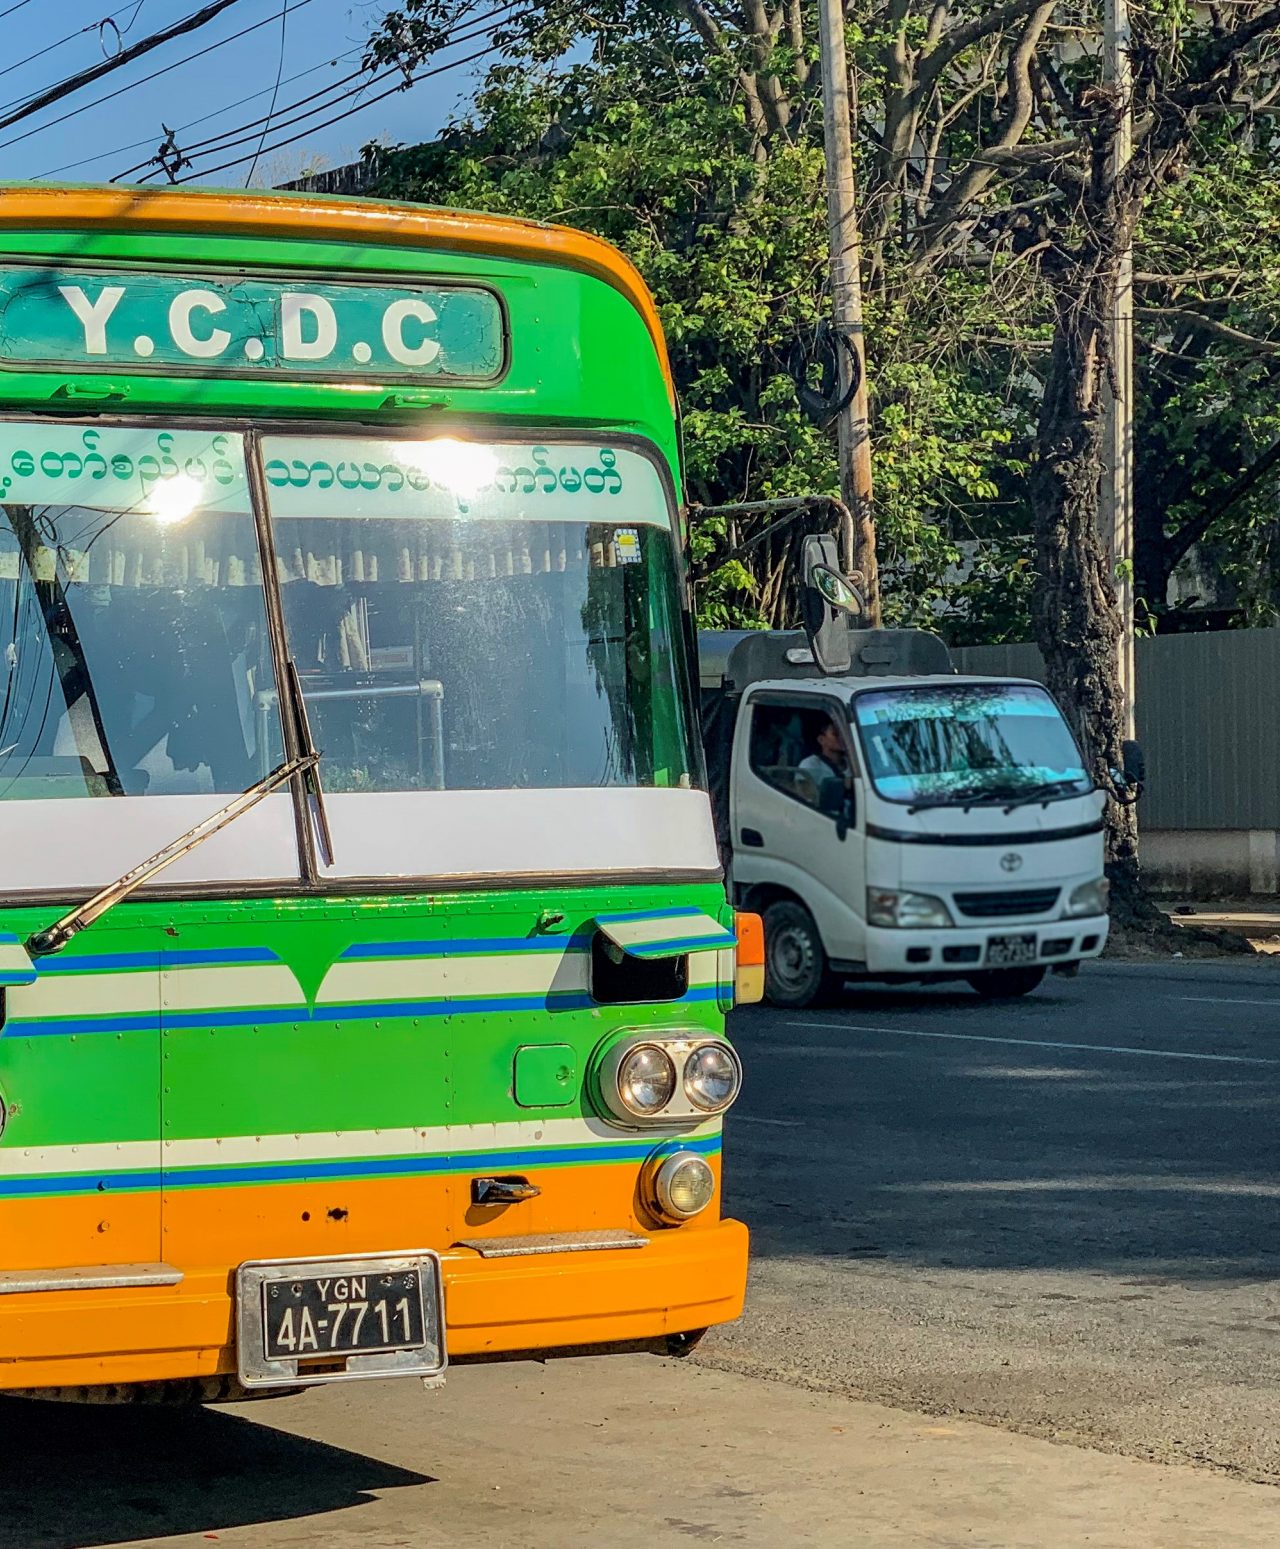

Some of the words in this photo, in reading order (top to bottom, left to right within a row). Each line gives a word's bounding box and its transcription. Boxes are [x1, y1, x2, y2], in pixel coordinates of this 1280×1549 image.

[57, 285, 441, 366] Y.C.D.C
[316, 1276, 367, 1302] YGN
[276, 1297, 412, 1351] 4A-7711
